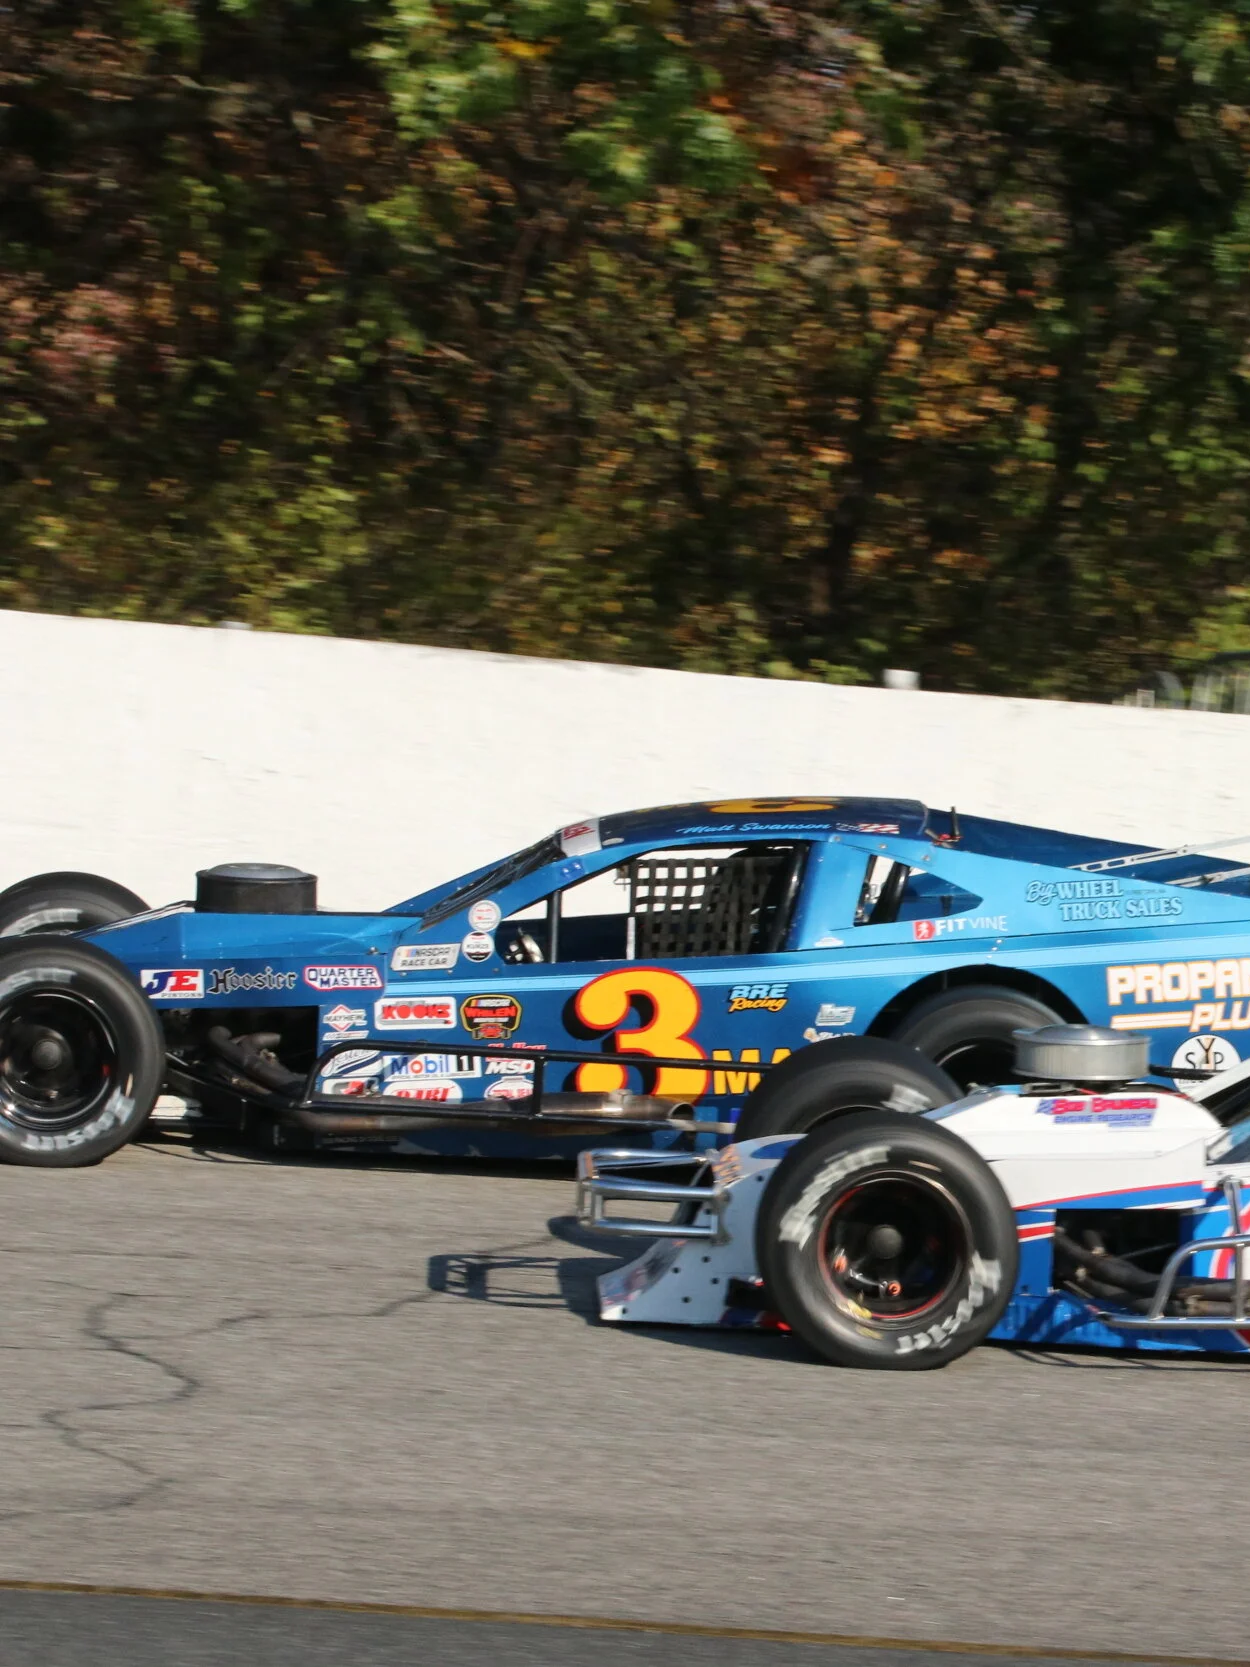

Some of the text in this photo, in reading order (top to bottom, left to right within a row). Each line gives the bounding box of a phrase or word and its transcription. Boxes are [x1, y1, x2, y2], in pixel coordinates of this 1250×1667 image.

[676, 824, 735, 834] Matt
[739, 822, 832, 832] Swanson
[1027, 879, 1124, 906] Big WHEEL
[1059, 897, 1183, 921] TRUCK SALES
[428, 958, 448, 966] CAR
[148, 970, 199, 994] JE
[207, 966, 299, 994] Hoosier
[308, 967, 375, 981] QUARTER
[320, 978, 379, 988] MASTER
[729, 983, 789, 1000] BRE
[728, 996, 788, 1012] Racing
[573, 966, 711, 1108] 3
[390, 1054, 449, 1074] Mobil
[461, 1055, 472, 1071] 1
